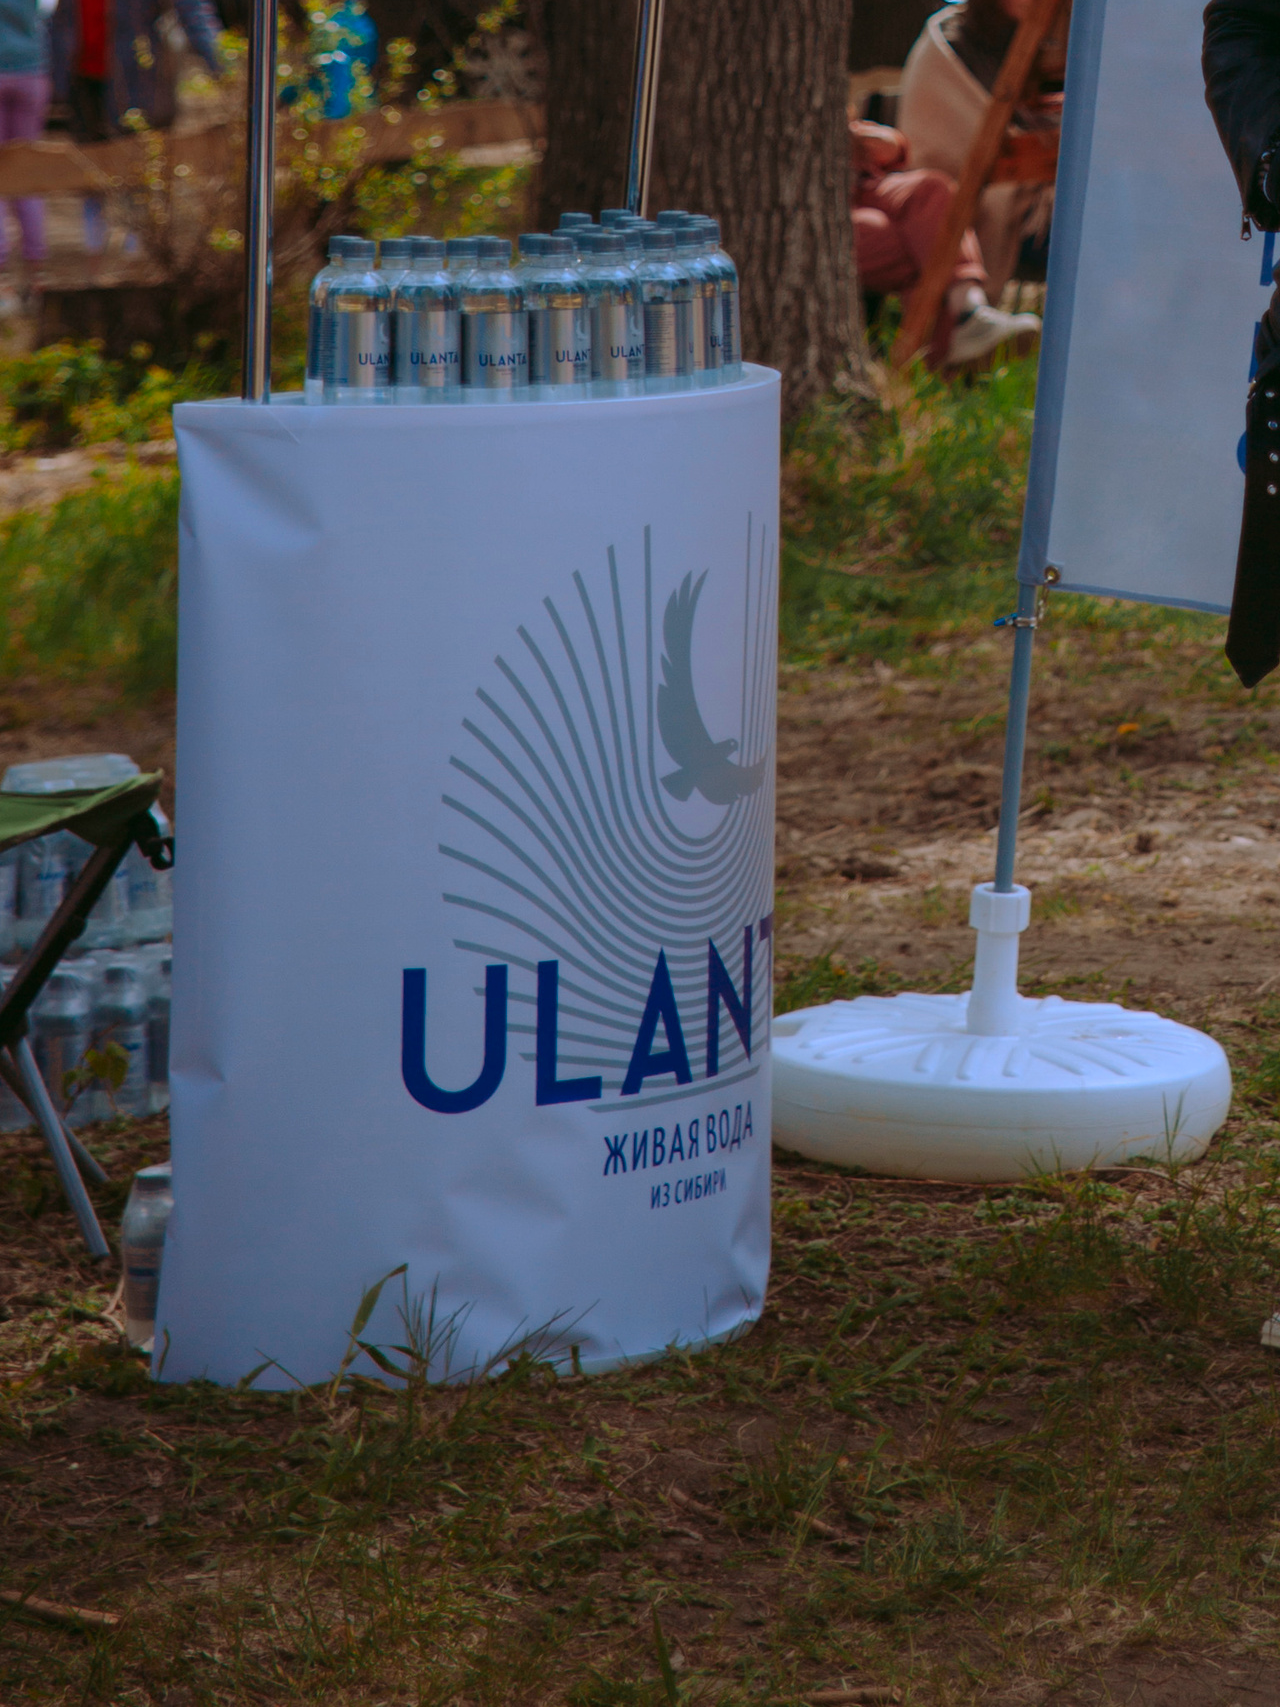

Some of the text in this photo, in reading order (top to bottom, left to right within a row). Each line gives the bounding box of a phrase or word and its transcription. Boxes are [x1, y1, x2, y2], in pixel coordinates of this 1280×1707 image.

[410, 351, 459, 365] ULANTA
[479, 353, 527, 367] ULANTA
[603, 1100, 753, 1176] ЖИВАЯ ВОДА
[650, 1168, 727, 1210] ИЗ СИБИРИ
